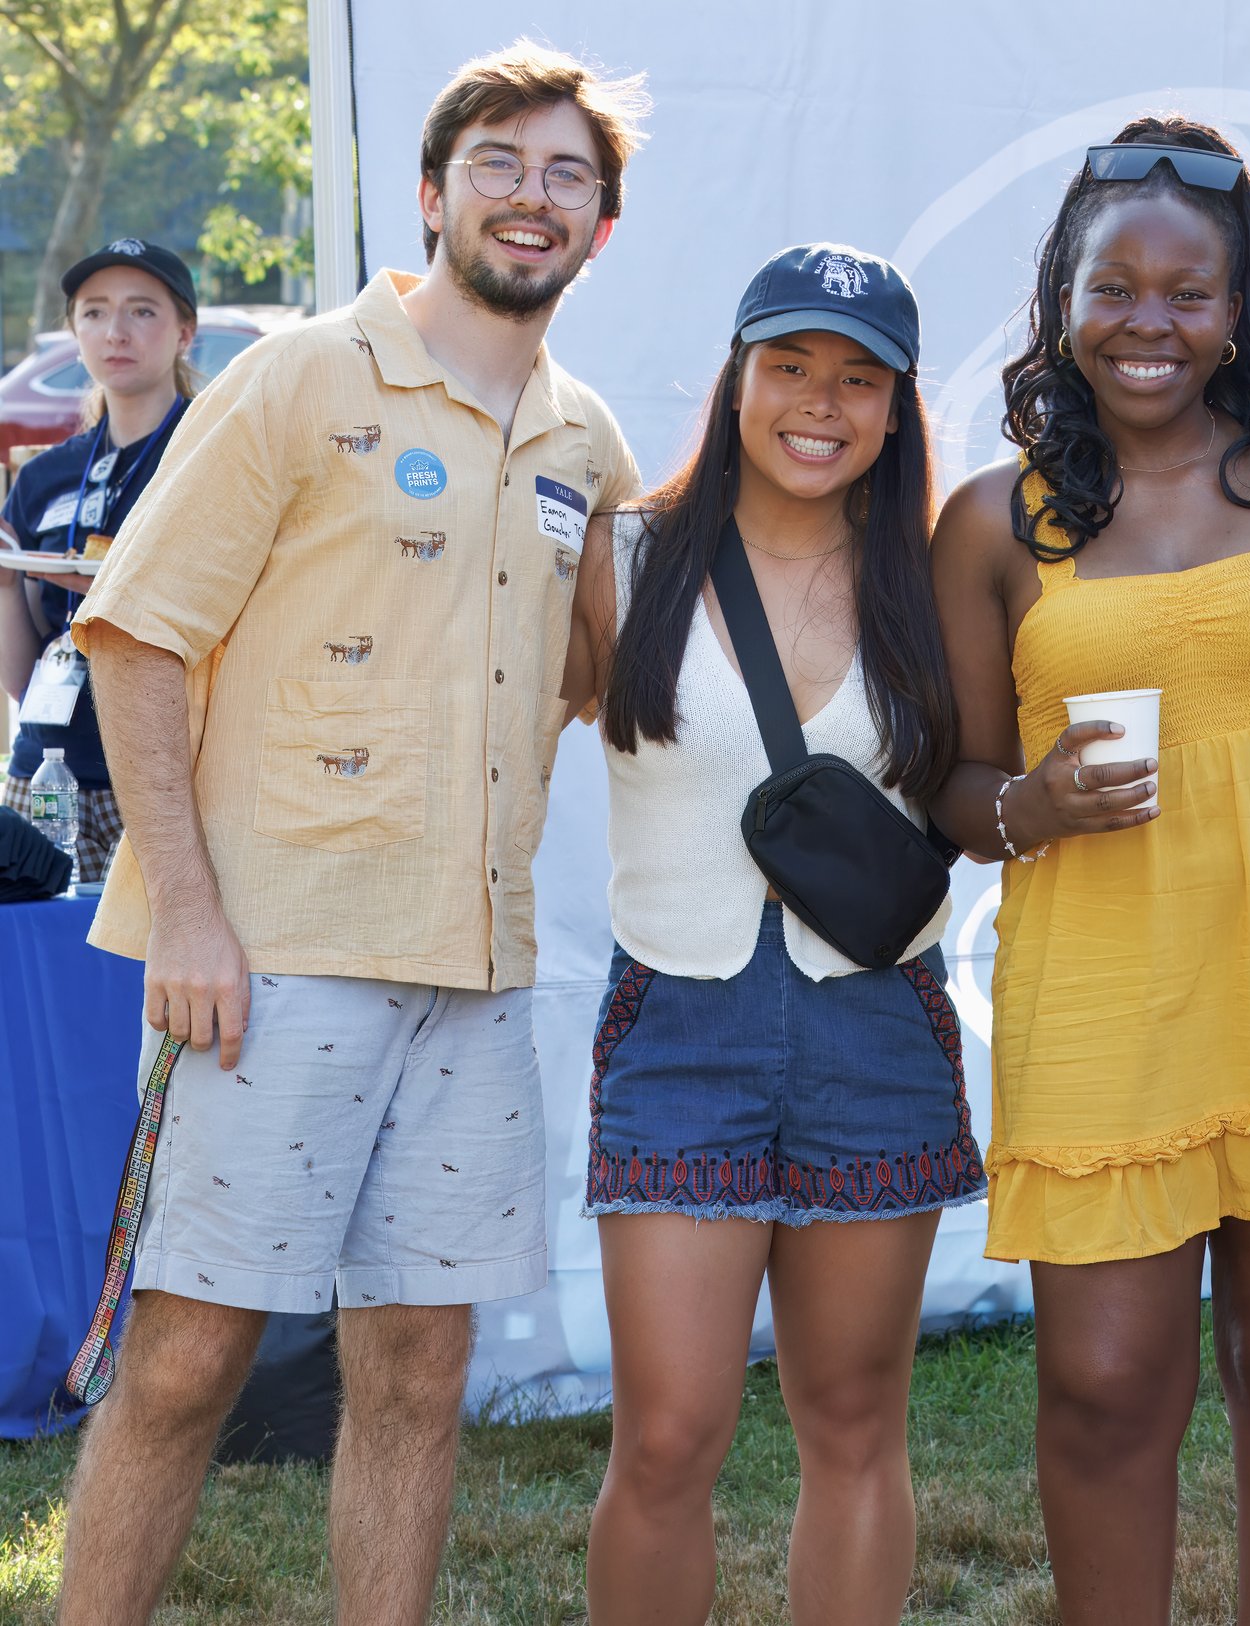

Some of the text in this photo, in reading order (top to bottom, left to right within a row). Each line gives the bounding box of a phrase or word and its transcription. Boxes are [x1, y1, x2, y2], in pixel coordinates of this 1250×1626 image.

[406, 470, 438, 480] FRESH
[407, 478, 439, 488] PRINTS
[554, 485, 573, 501] YALE
